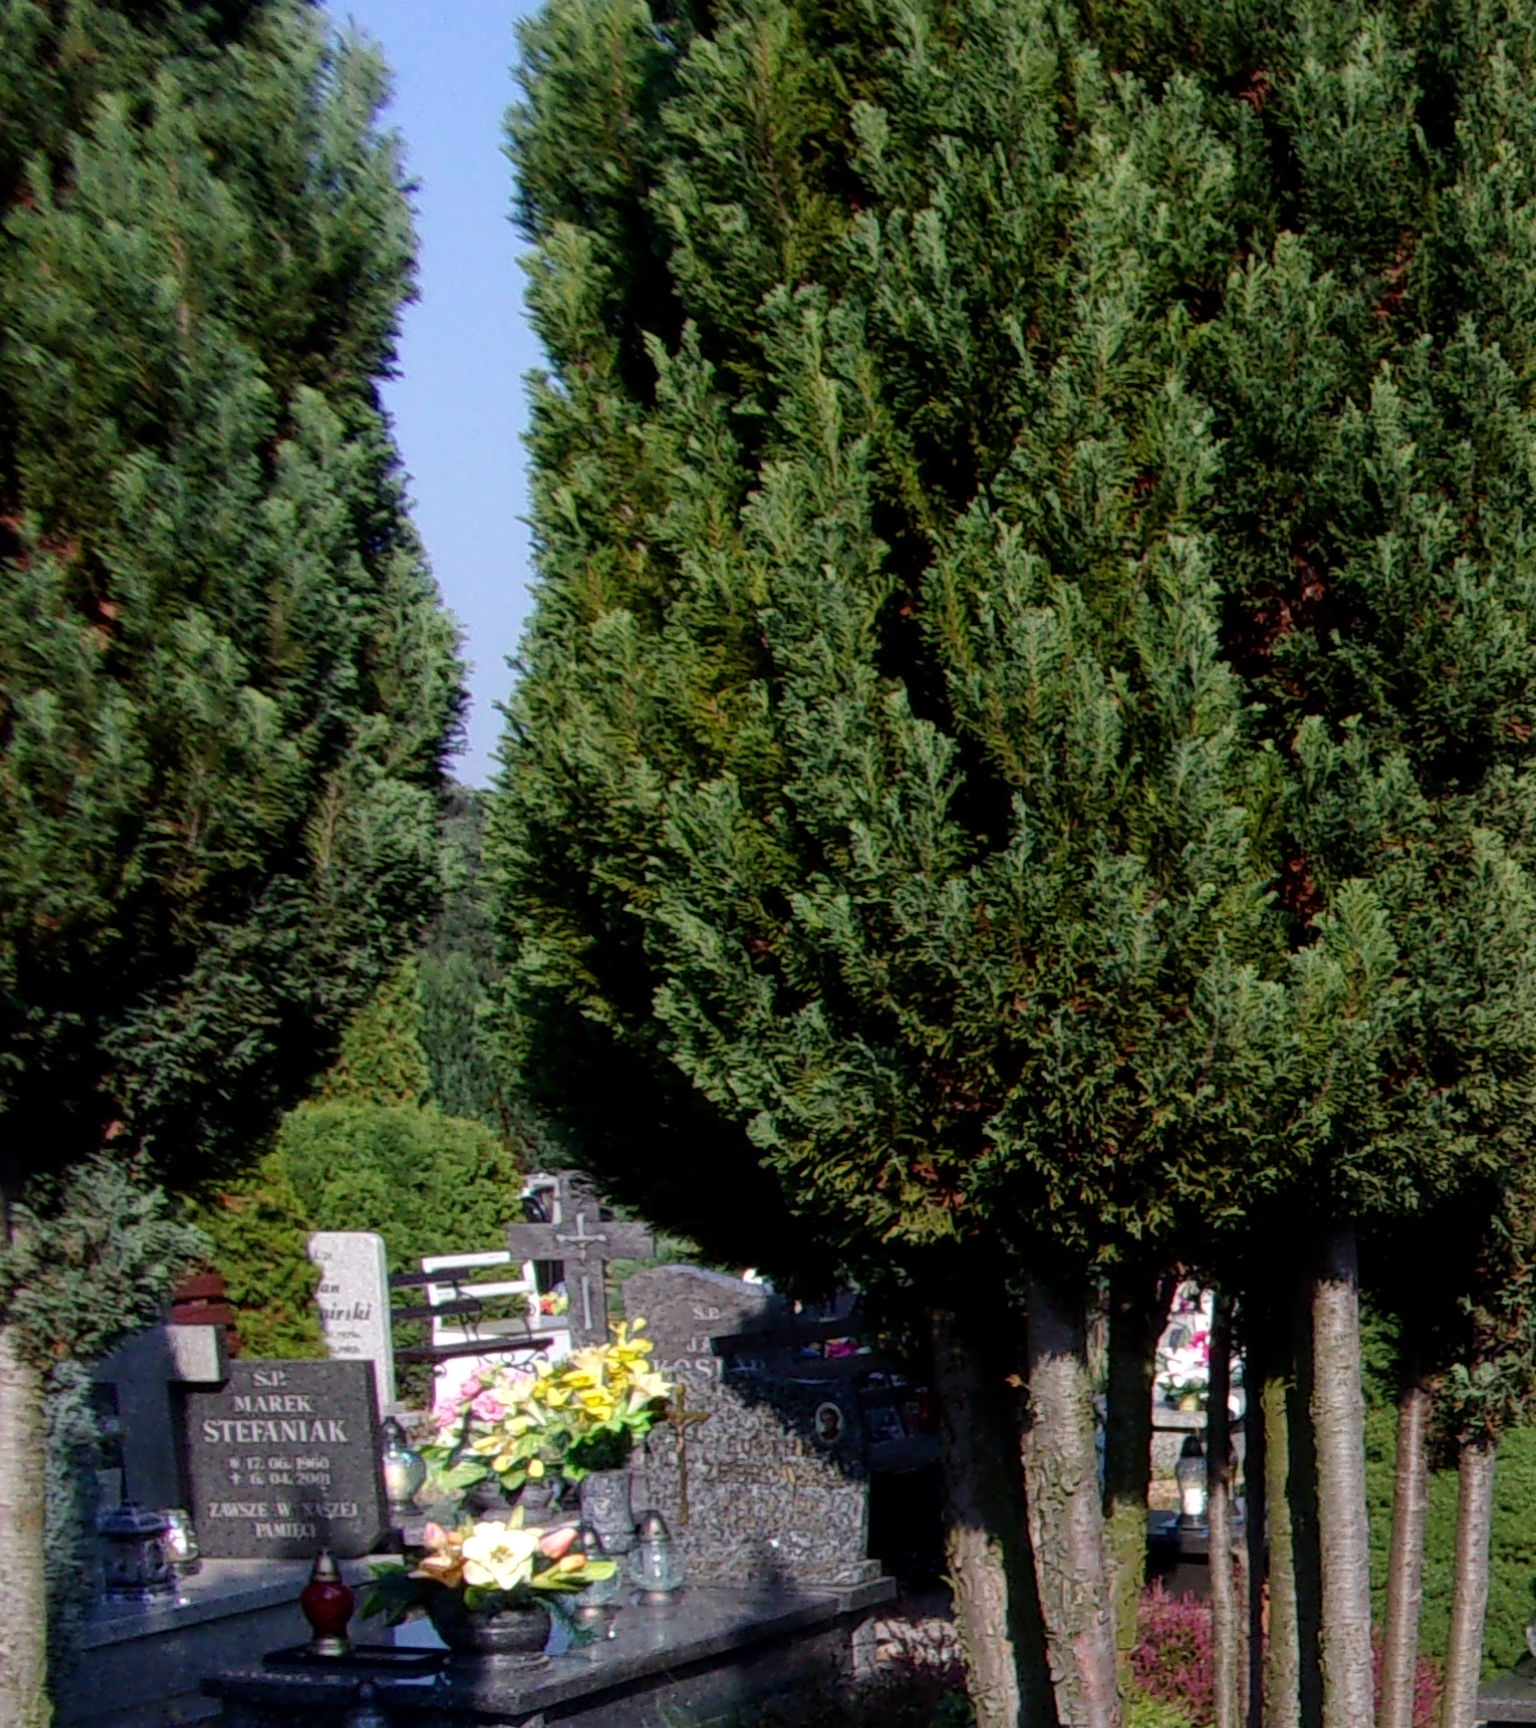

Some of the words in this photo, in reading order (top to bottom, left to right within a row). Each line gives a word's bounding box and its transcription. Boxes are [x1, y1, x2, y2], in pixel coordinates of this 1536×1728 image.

[233, 1394, 316, 1413] MAREK
[202, 1418, 349, 1443] STEFANIAK
[277, 1502, 293, 1517] W
